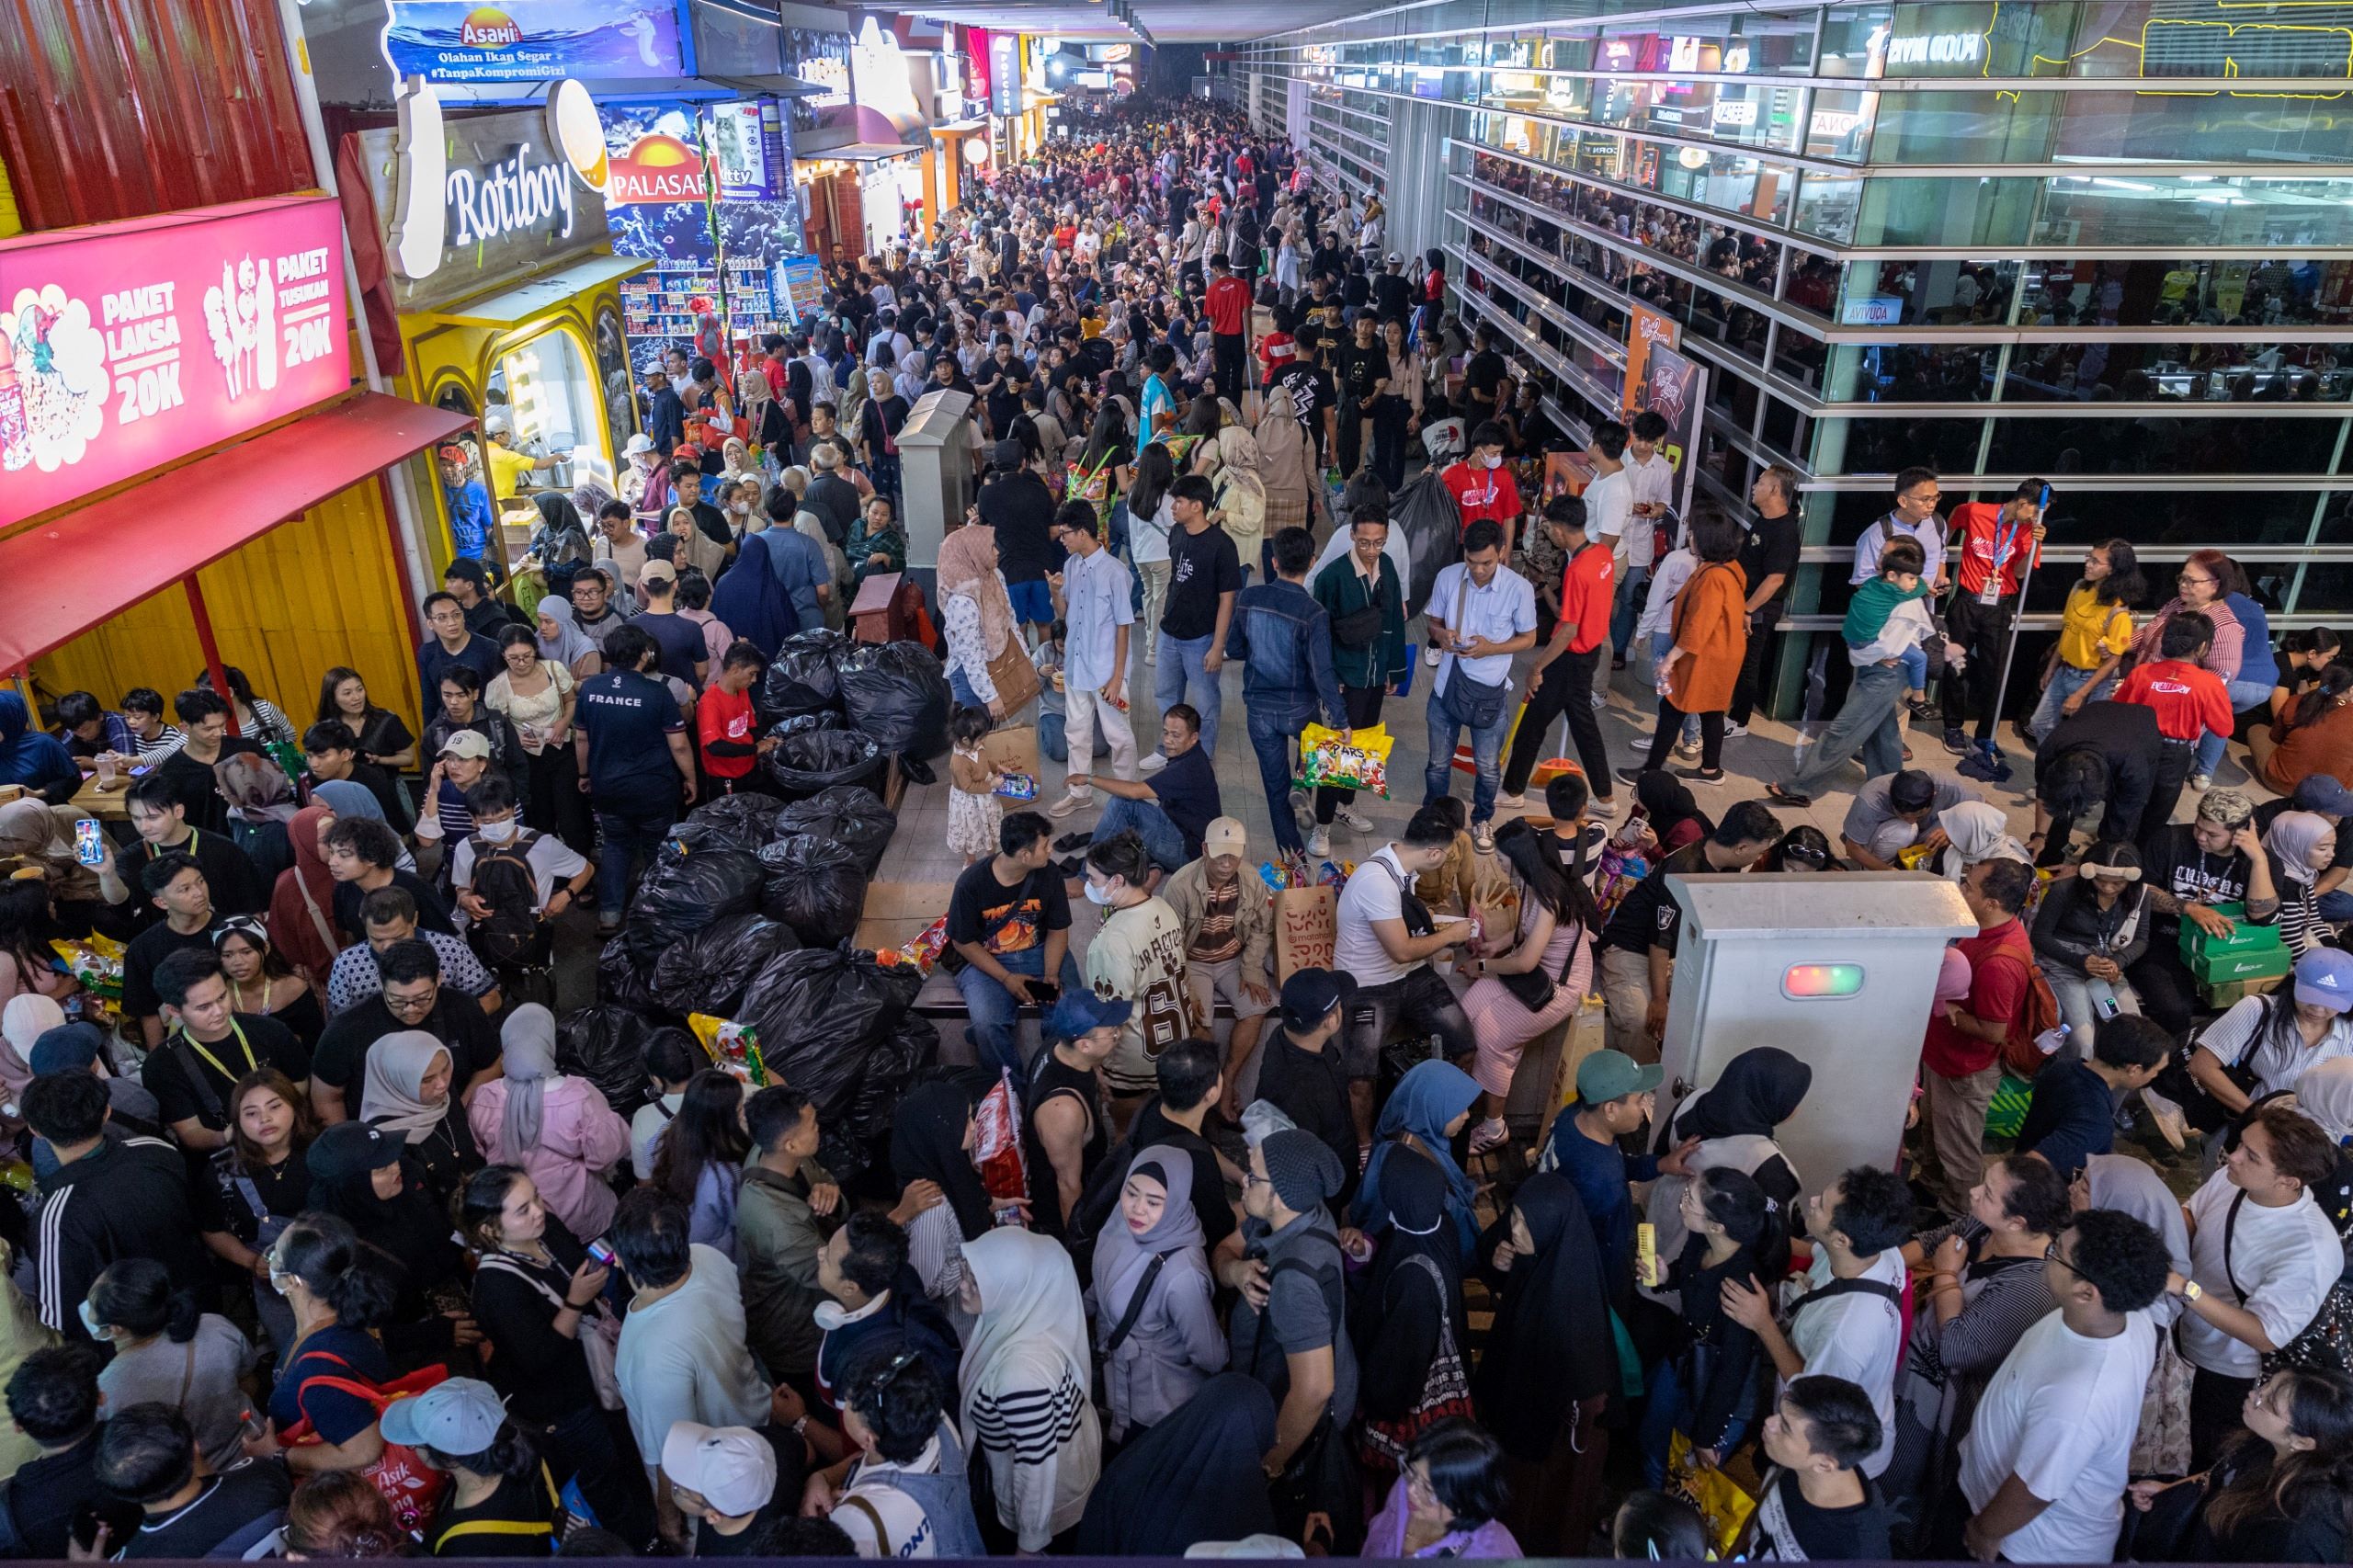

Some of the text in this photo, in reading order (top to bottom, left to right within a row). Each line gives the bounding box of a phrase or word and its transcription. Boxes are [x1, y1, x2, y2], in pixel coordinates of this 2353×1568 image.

[431, 66, 566, 80] #TanpaKompromiGizi
[438, 51, 551, 63] Olahan Ikan Segar
[1000, 53, 1011, 115] POPCORN
[447, 142, 574, 246] Rotiboy
[277, 247, 328, 284] PAKET
[102, 281, 175, 326] PAKET
[278, 279, 329, 308] TUSUKAN
[107, 315, 181, 361] LAKSA
[284, 315, 332, 369] 20K
[113, 362, 184, 426] 20K
[1282, 372, 1318, 388] GEF
[588, 694, 642, 707] FRANCE
[378, 1461, 411, 1490] Asik
[392, 1494, 414, 1513] ng
